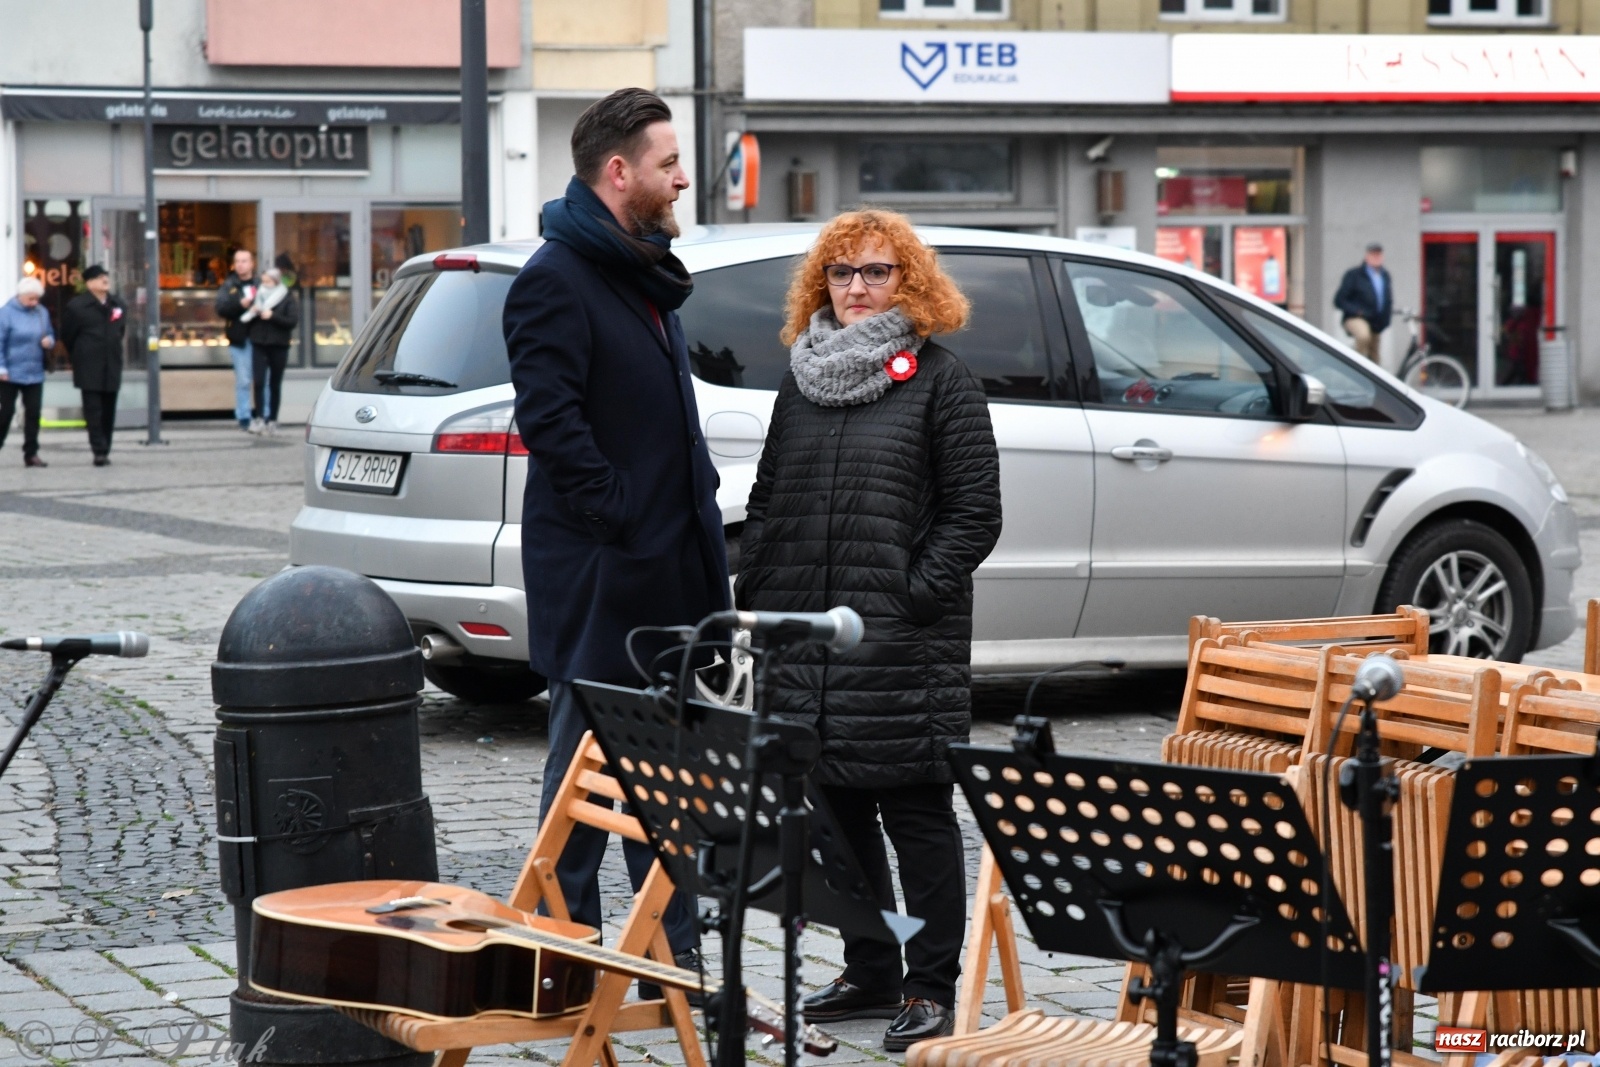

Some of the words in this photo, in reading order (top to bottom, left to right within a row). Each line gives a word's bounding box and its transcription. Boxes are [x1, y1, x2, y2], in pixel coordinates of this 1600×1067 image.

[955, 43, 1017, 67] TEB
[953, 73, 1019, 85] EDUKACJA
[171, 123, 354, 167] gelatopiu
[333, 453, 362, 481] SJZ
[360, 455, 398, 484] 9RH9
